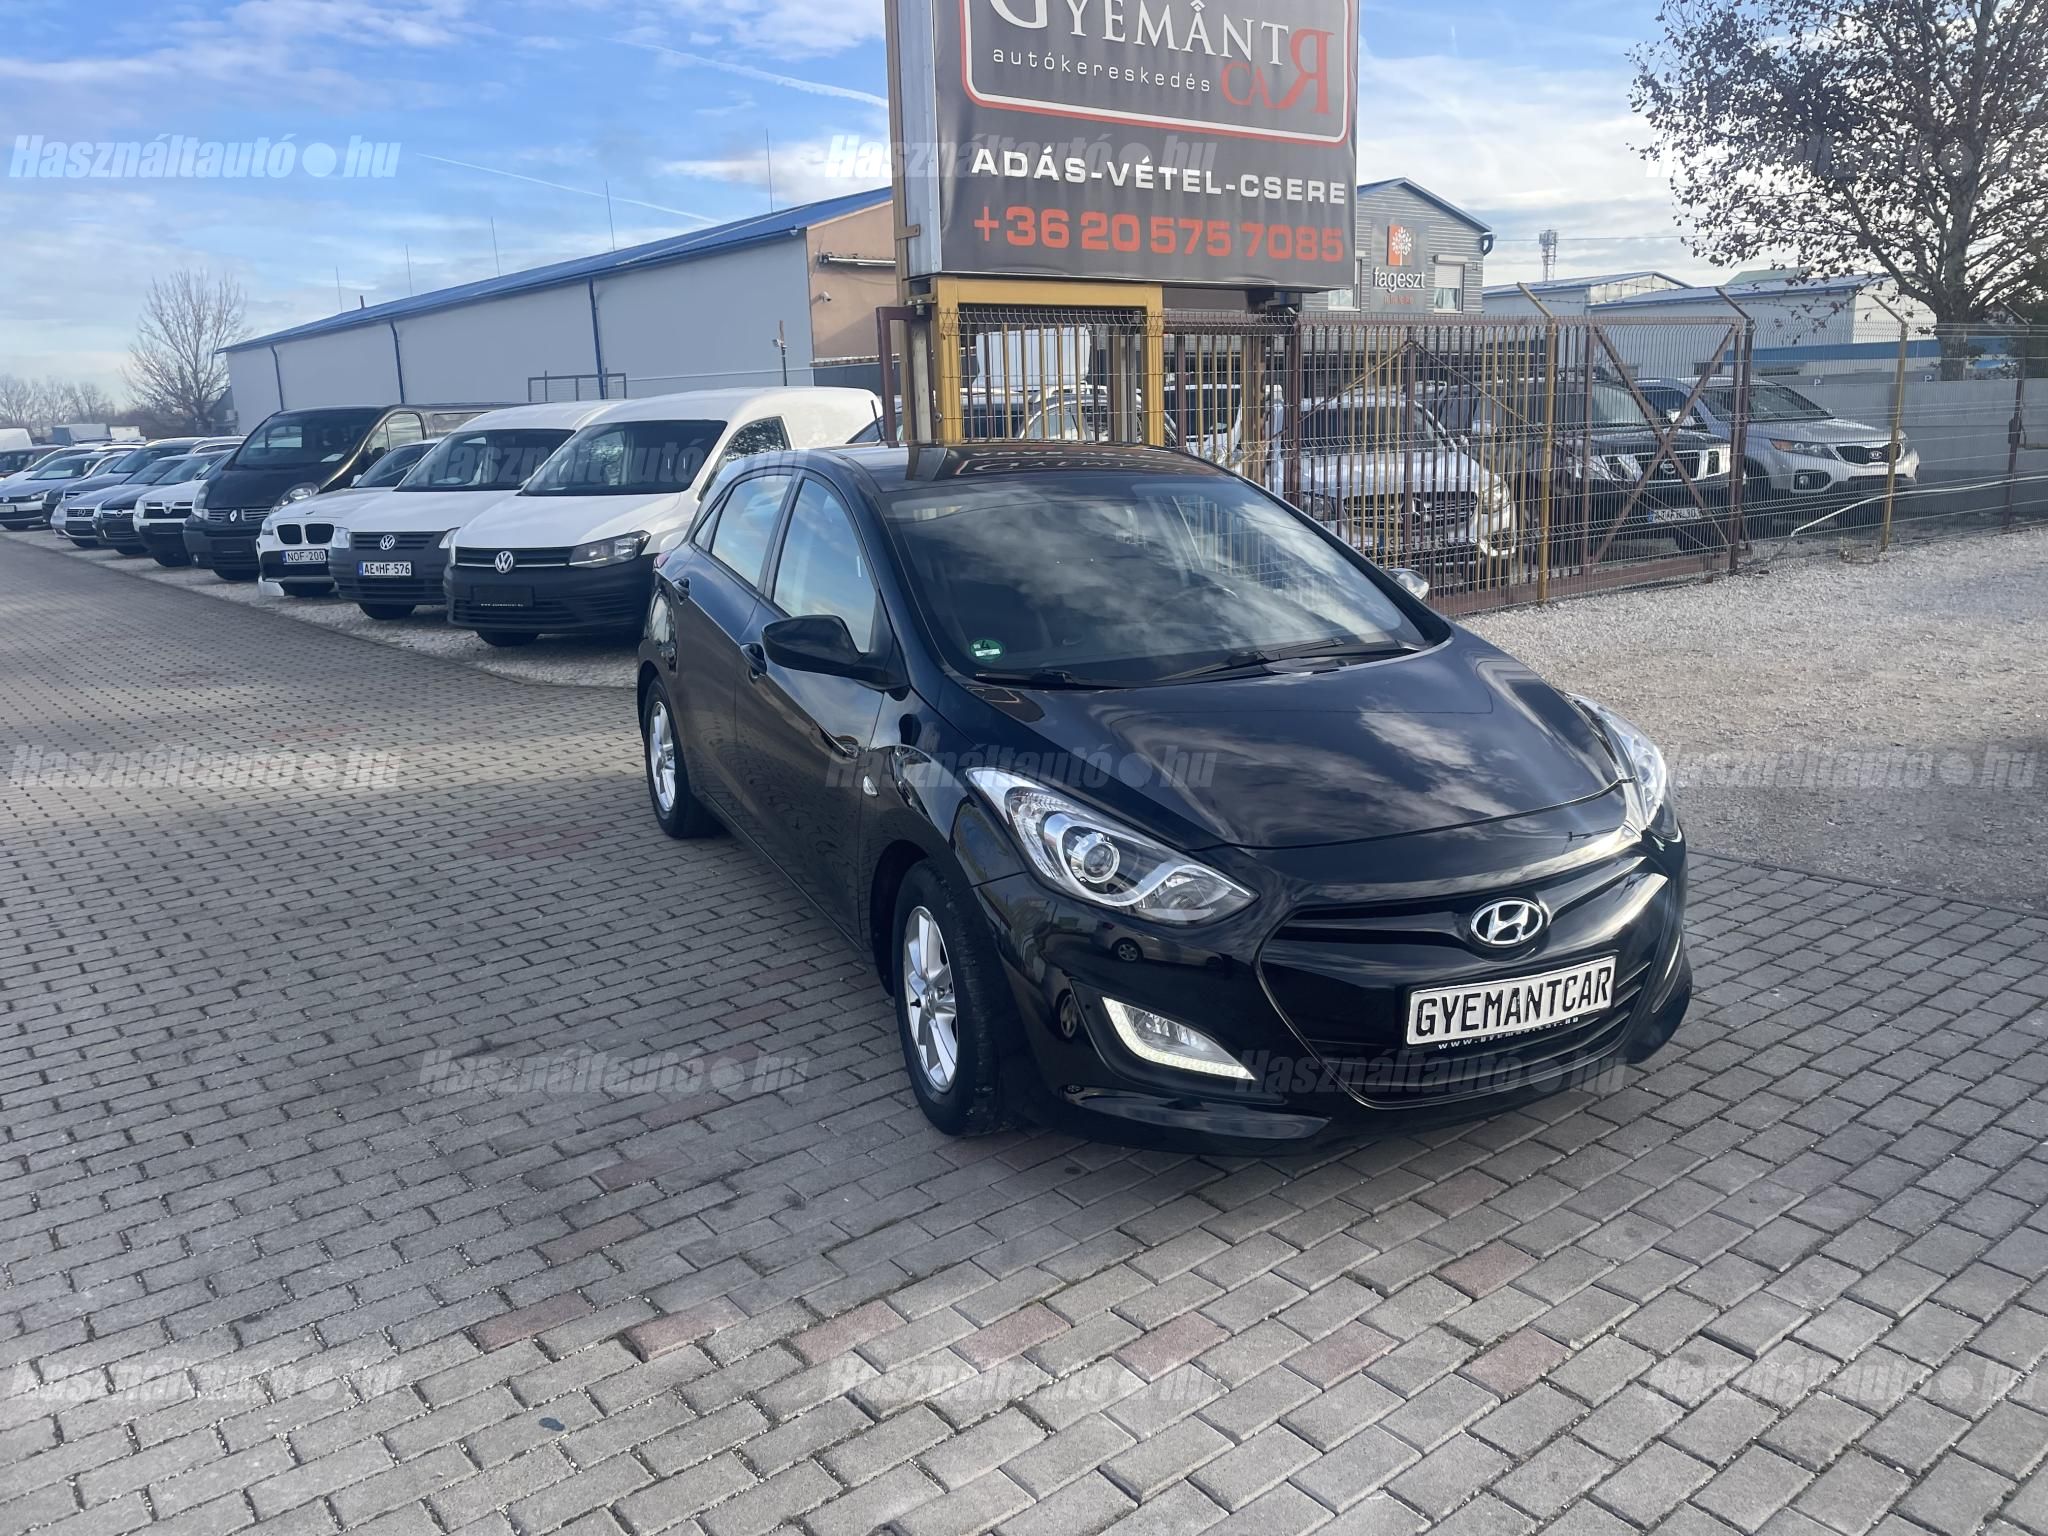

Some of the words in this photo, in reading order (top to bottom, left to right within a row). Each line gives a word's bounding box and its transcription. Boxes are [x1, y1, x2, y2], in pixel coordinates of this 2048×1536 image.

[993, 48, 1211, 93] autókereskedés
[971, 144, 1346, 205] ADÁS-VÉTEL-CSERE
[973, 205, 1070, 249] +36
[1079, 211, 1142, 252] 20
[1150, 216, 1232, 257] 575
[1239, 221, 1345, 262] 7085
[1373, 266, 1426, 293] fageszt
[287, 551, 325, 561] NOF-200
[1415, 965, 1613, 1037] GYEMANTCAR
